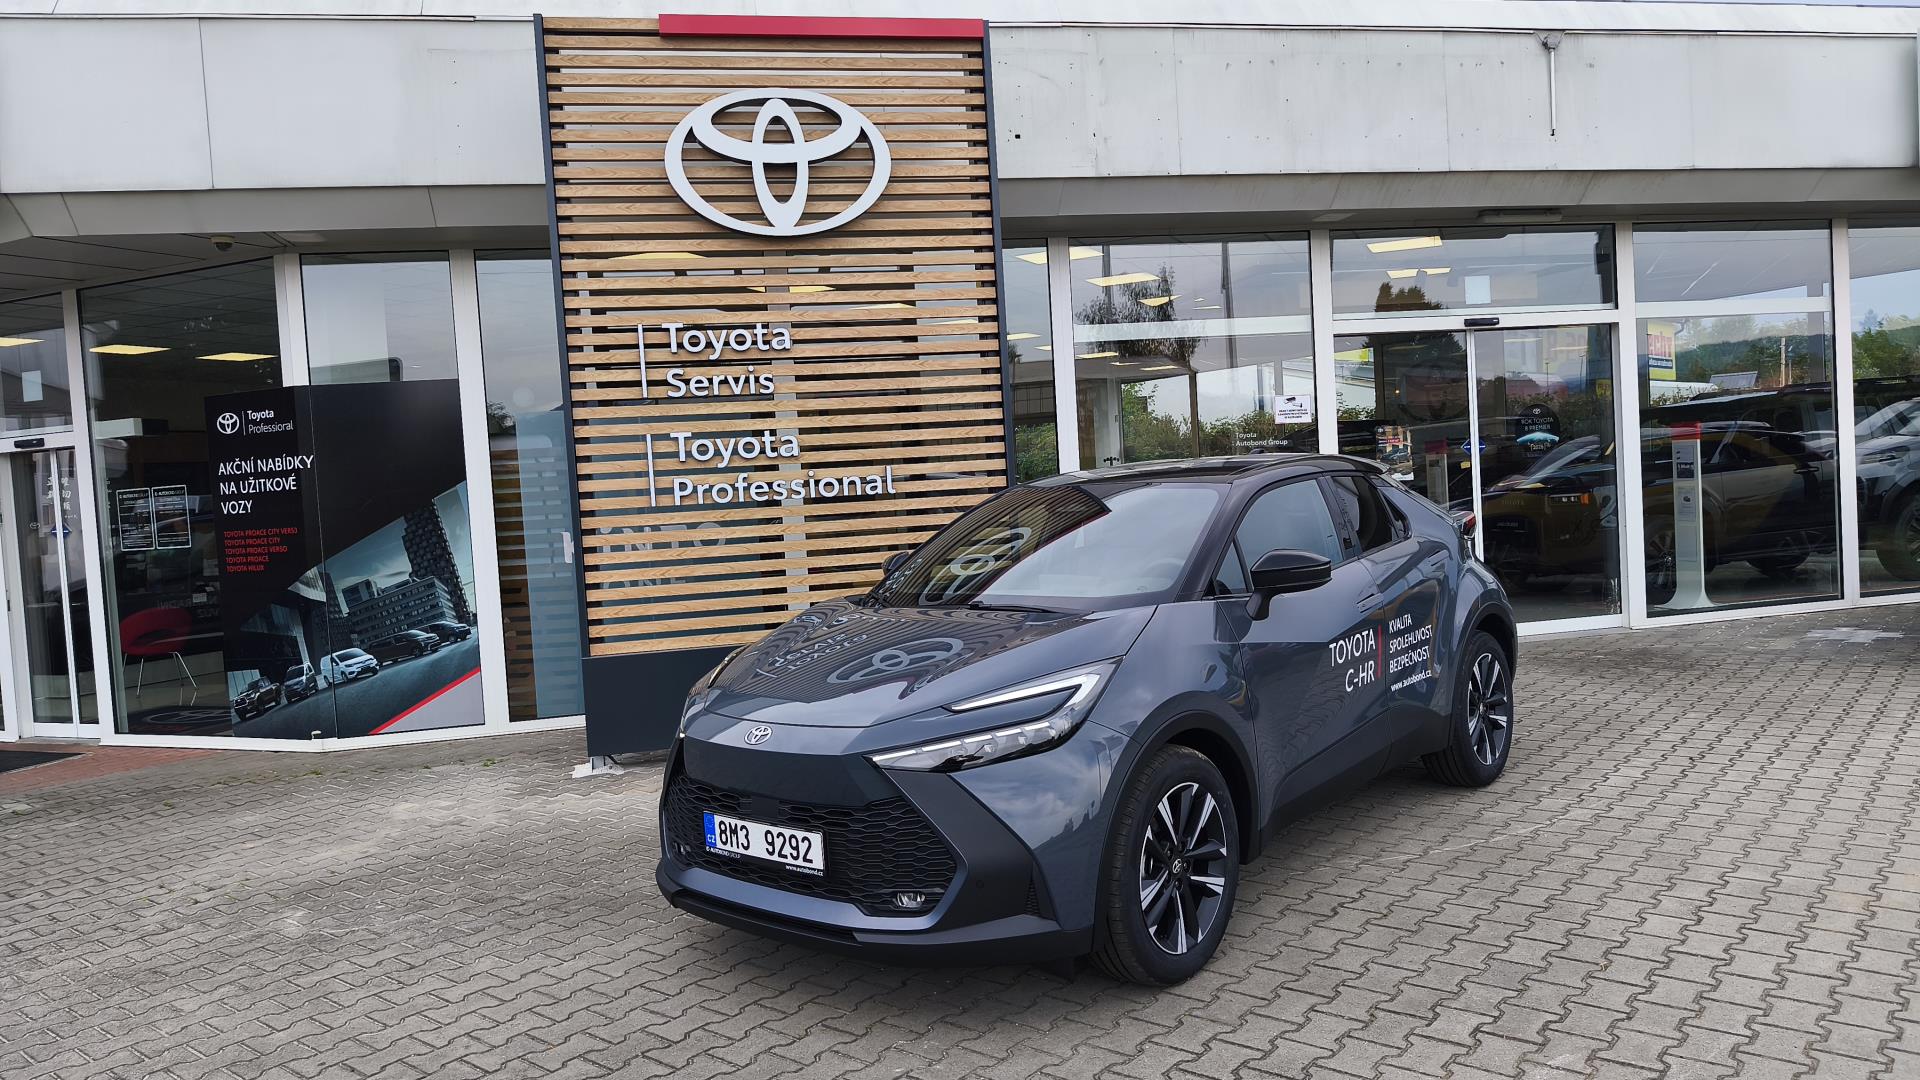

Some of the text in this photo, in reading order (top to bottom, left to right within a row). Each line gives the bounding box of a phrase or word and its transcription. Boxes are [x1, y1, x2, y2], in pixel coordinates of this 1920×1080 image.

[661, 322, 792, 360] Toyota
[665, 365, 775, 398] Servis
[246, 409, 274, 421] Toyota
[248, 420, 294, 434] Professional
[1235, 432, 1257, 440] Toyota
[670, 430, 800, 469] Toyota
[1235, 439, 1267, 447] Autobond
[218, 453, 314, 475] AKČNÍ NABÍDKY
[220, 473, 297, 495] NA UŽITKOVÉ
[673, 465, 896, 506] Professional
[220, 500, 253, 514] VOZY
[1388, 613, 1413, 634] KVALITA
[1329, 628, 1376, 667] TOYOTA
[1389, 624, 1433, 654] SPOLEHLIVOST
[1389, 645, 1430, 673] BEZPEČNOST
[1345, 660, 1375, 692] C-HR
[1390, 669, 1433, 692] www.autobond.cz
[707, 834, 716, 843] CZ
[718, 820, 814, 864] 8M3 9292
[785, 865, 824, 877] www.autobond.cz
